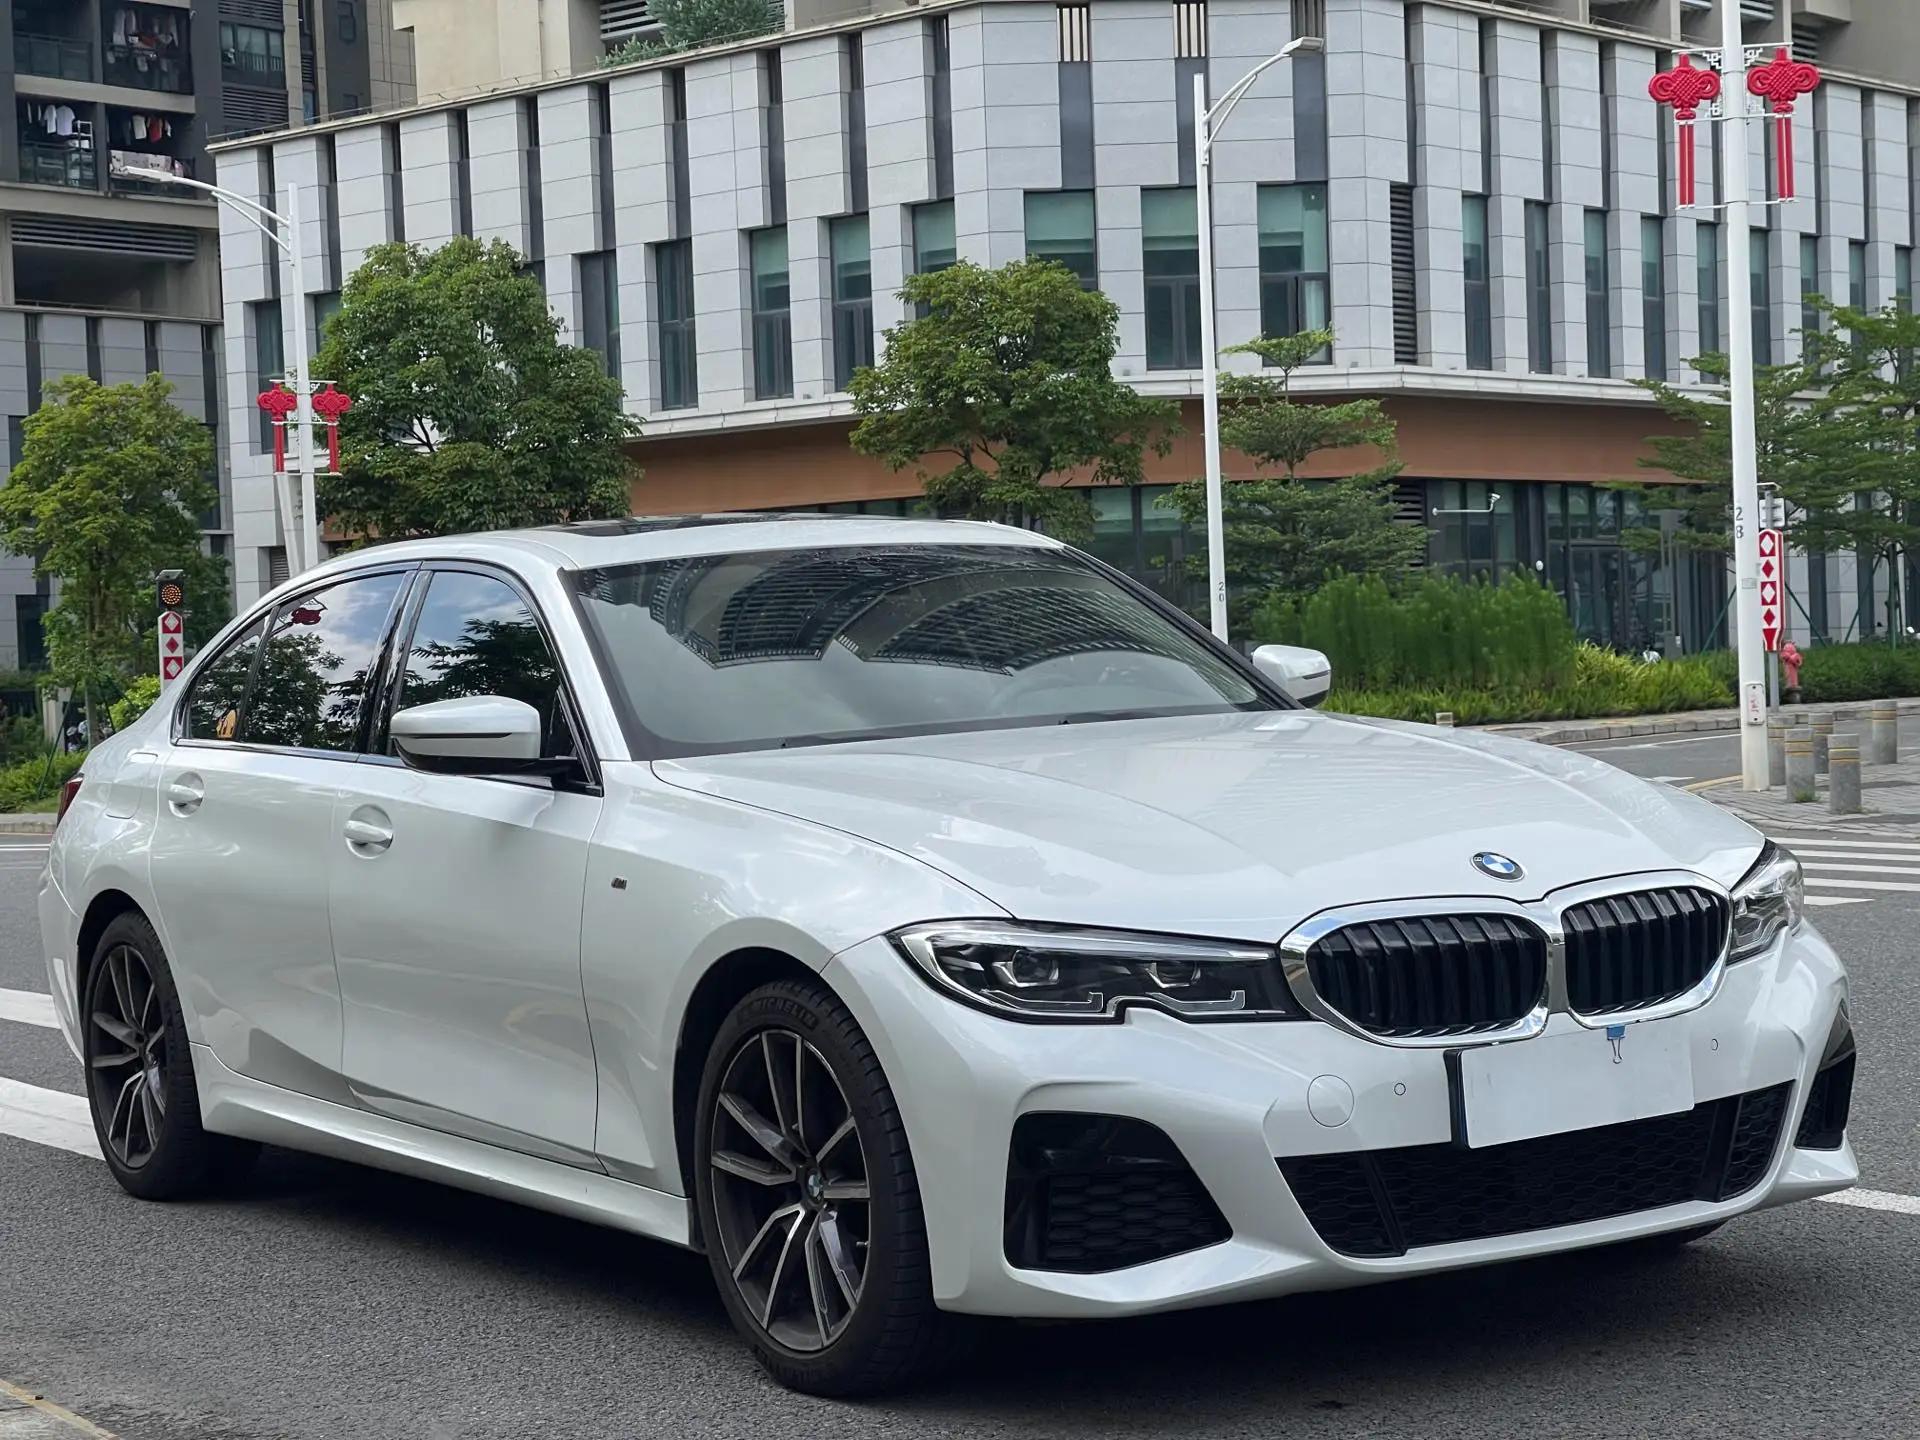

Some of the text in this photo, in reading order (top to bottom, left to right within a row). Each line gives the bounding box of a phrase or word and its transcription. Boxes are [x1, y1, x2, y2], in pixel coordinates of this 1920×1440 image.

[1735, 506, 1744, 539] 28
[1218, 581, 1225, 602] 20
[752, 997, 817, 1026] MICHELIN
